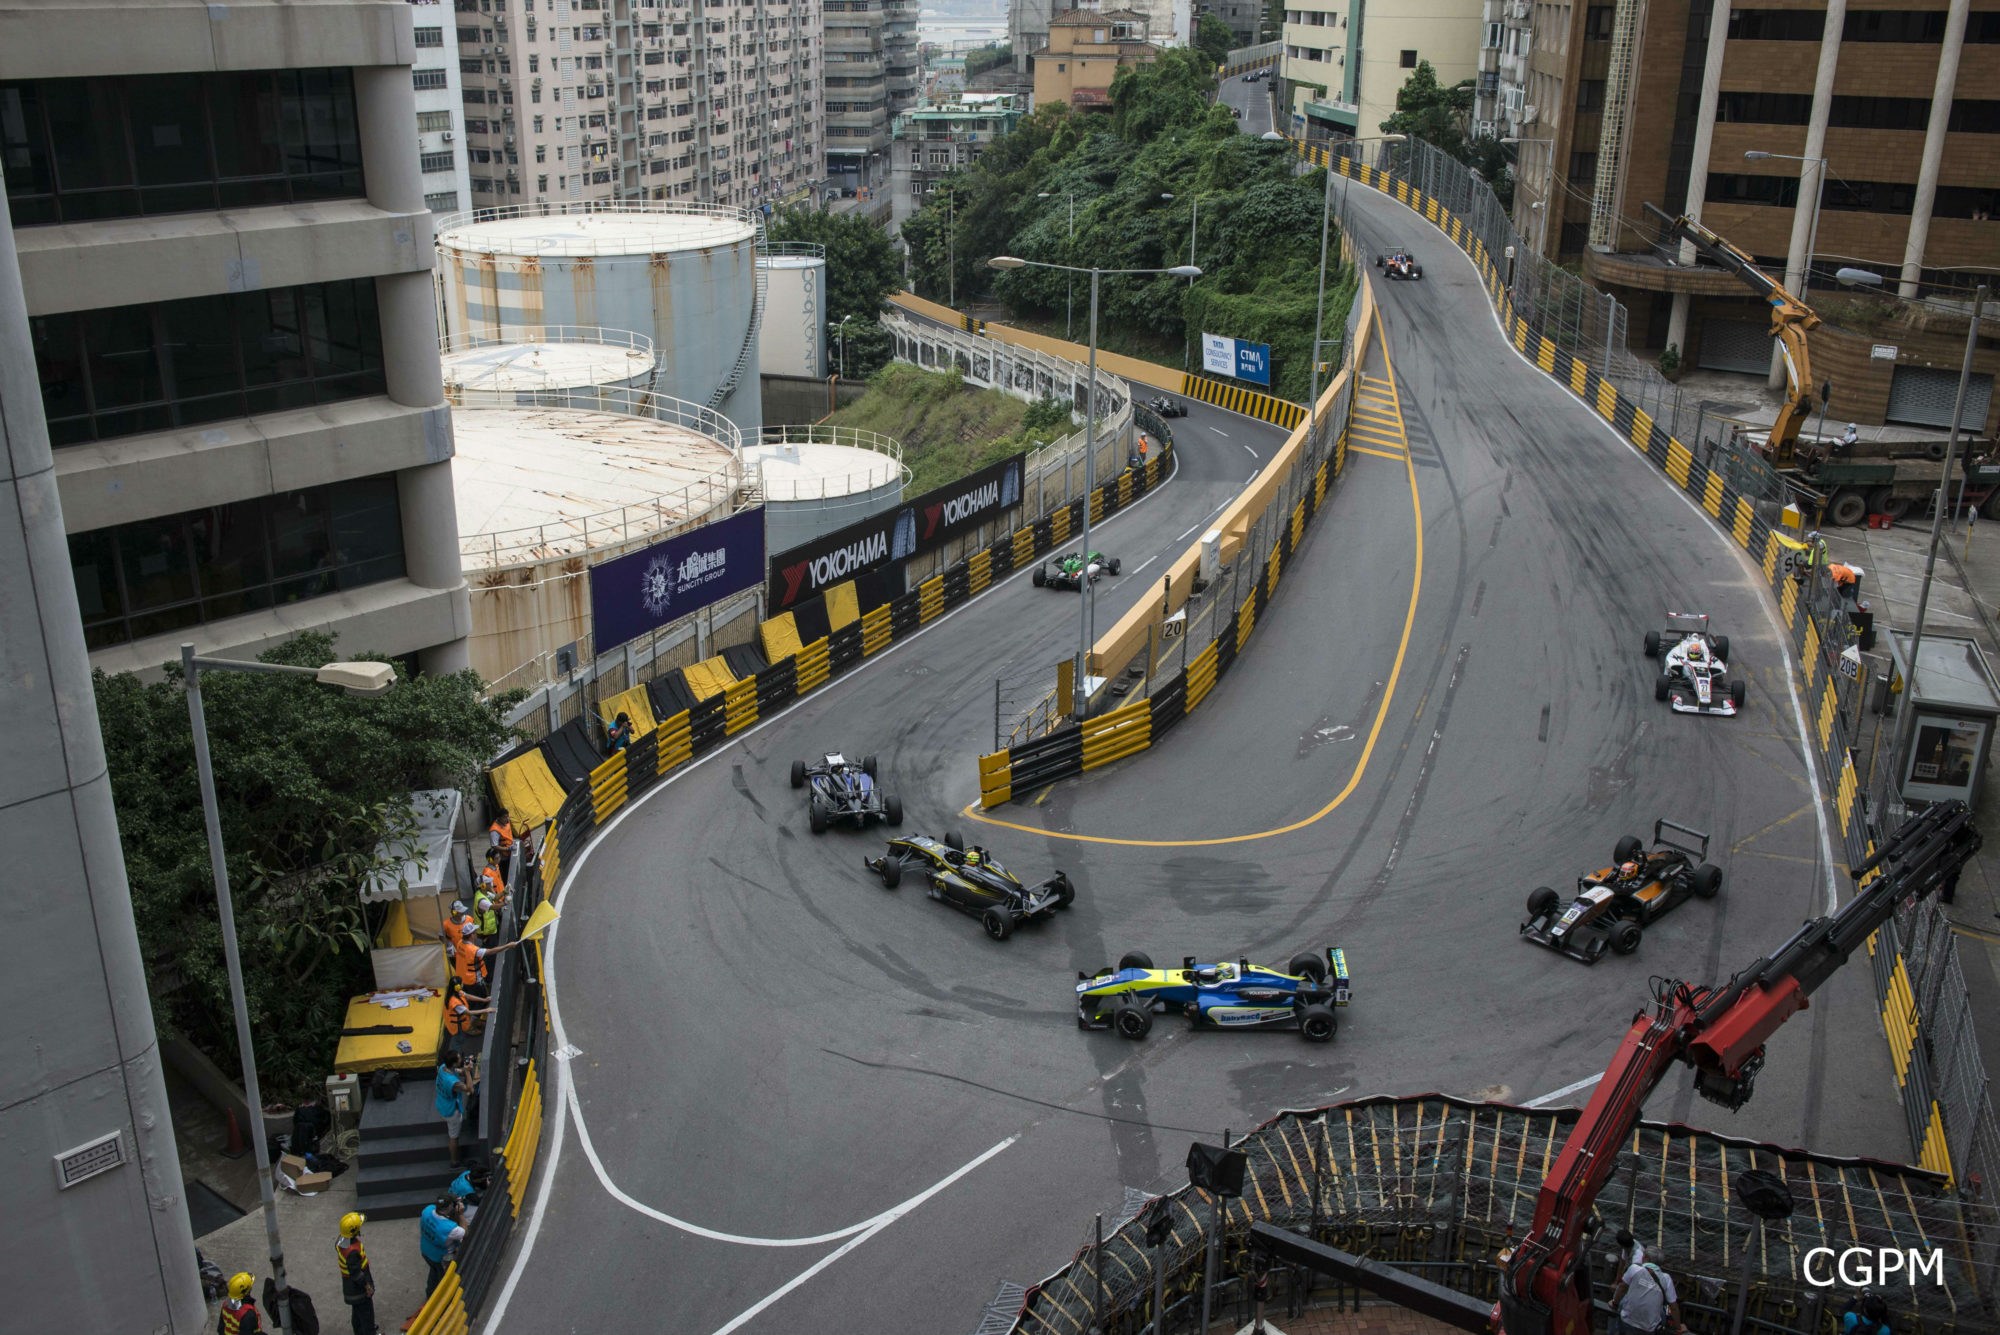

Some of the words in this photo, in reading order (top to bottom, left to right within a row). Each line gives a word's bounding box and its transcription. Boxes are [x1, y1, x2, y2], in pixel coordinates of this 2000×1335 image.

[1212, 340, 1225, 350] TATA
[1210, 358, 1228, 369] SERVICES
[1240, 349, 1256, 362] CTM
[943, 480, 999, 527] YOKOHAMA
[809, 530, 887, 589] YOKOHAMA
[677, 576, 704, 594] SUNCITY
[704, 568, 726, 582] GROUP
[1165, 621, 1182, 637] 20
[1839, 656, 1858, 679] 20B
[1566, 909, 1578, 920] 19
